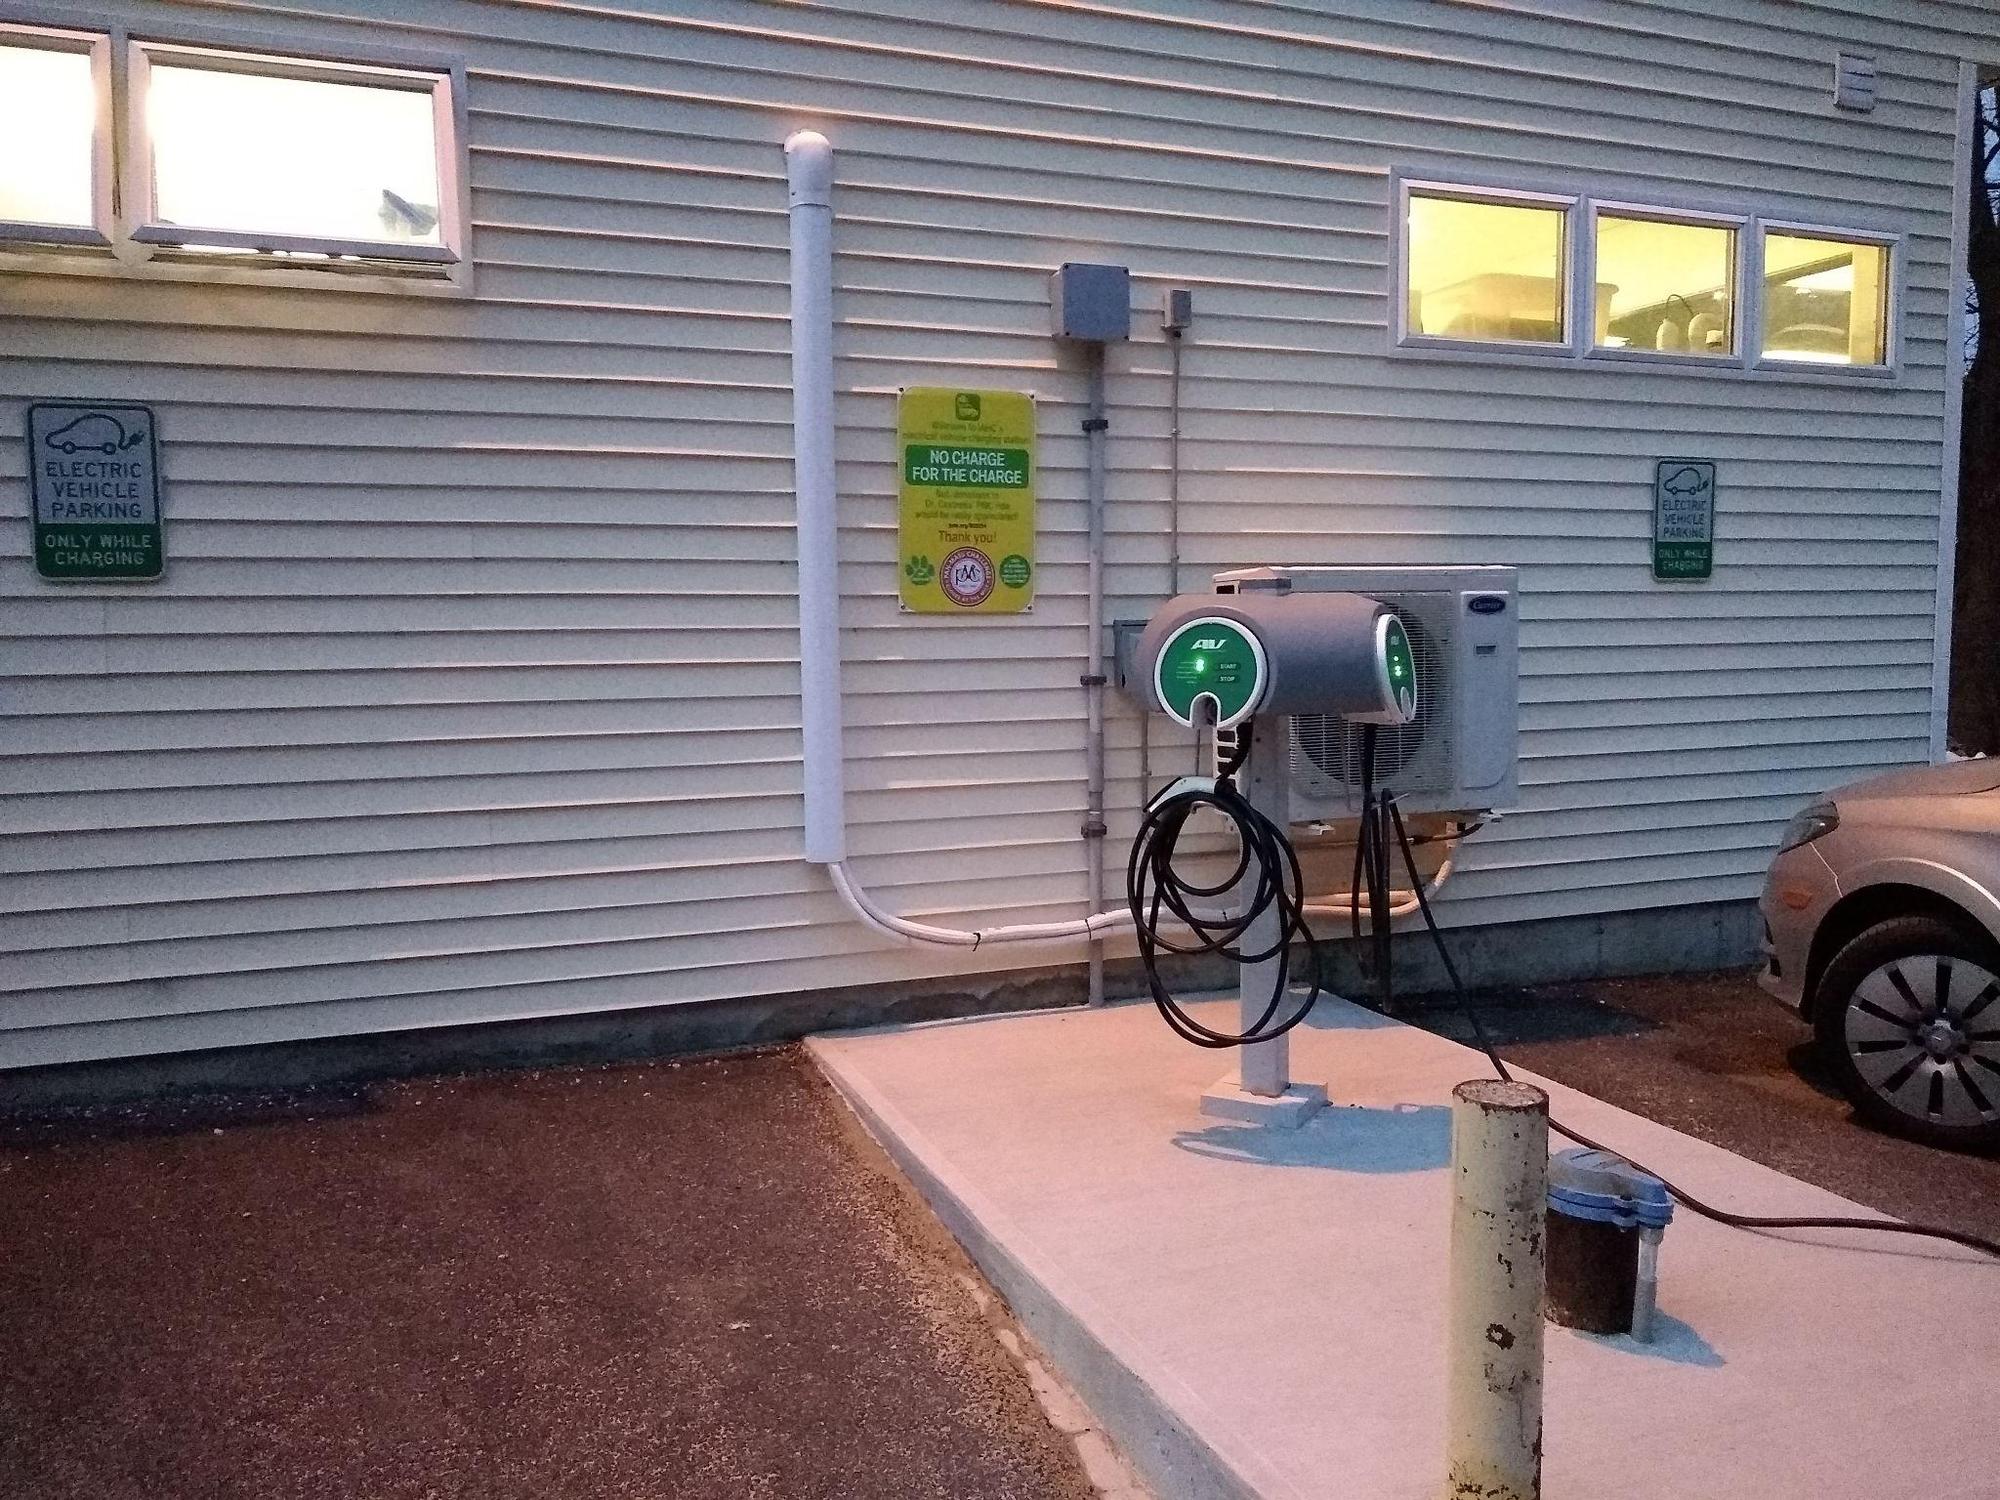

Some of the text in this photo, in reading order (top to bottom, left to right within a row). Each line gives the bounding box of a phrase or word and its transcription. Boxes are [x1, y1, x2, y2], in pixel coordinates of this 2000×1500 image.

[930, 450, 1005, 467] NO CHARGE
[46, 461, 142, 478] ELECTRIC
[912, 467, 1023, 484] FOR THE CHARGE
[51, 482, 140, 499] VEHICLE
[51, 502, 142, 519] PARKING
[1663, 500, 1706, 511] ELECTRIC
[1663, 514, 1705, 525] VEHICLE
[938, 530, 997, 545] Thank you!
[1663, 527, 1705, 538] PARKING
[45, 534, 153, 549] ONLY WHILE
[54, 551, 146, 567] CHARGING
[1658, 549, 1708, 559] ONLY WHILE
[1662, 560, 1704, 571] CHARGING
